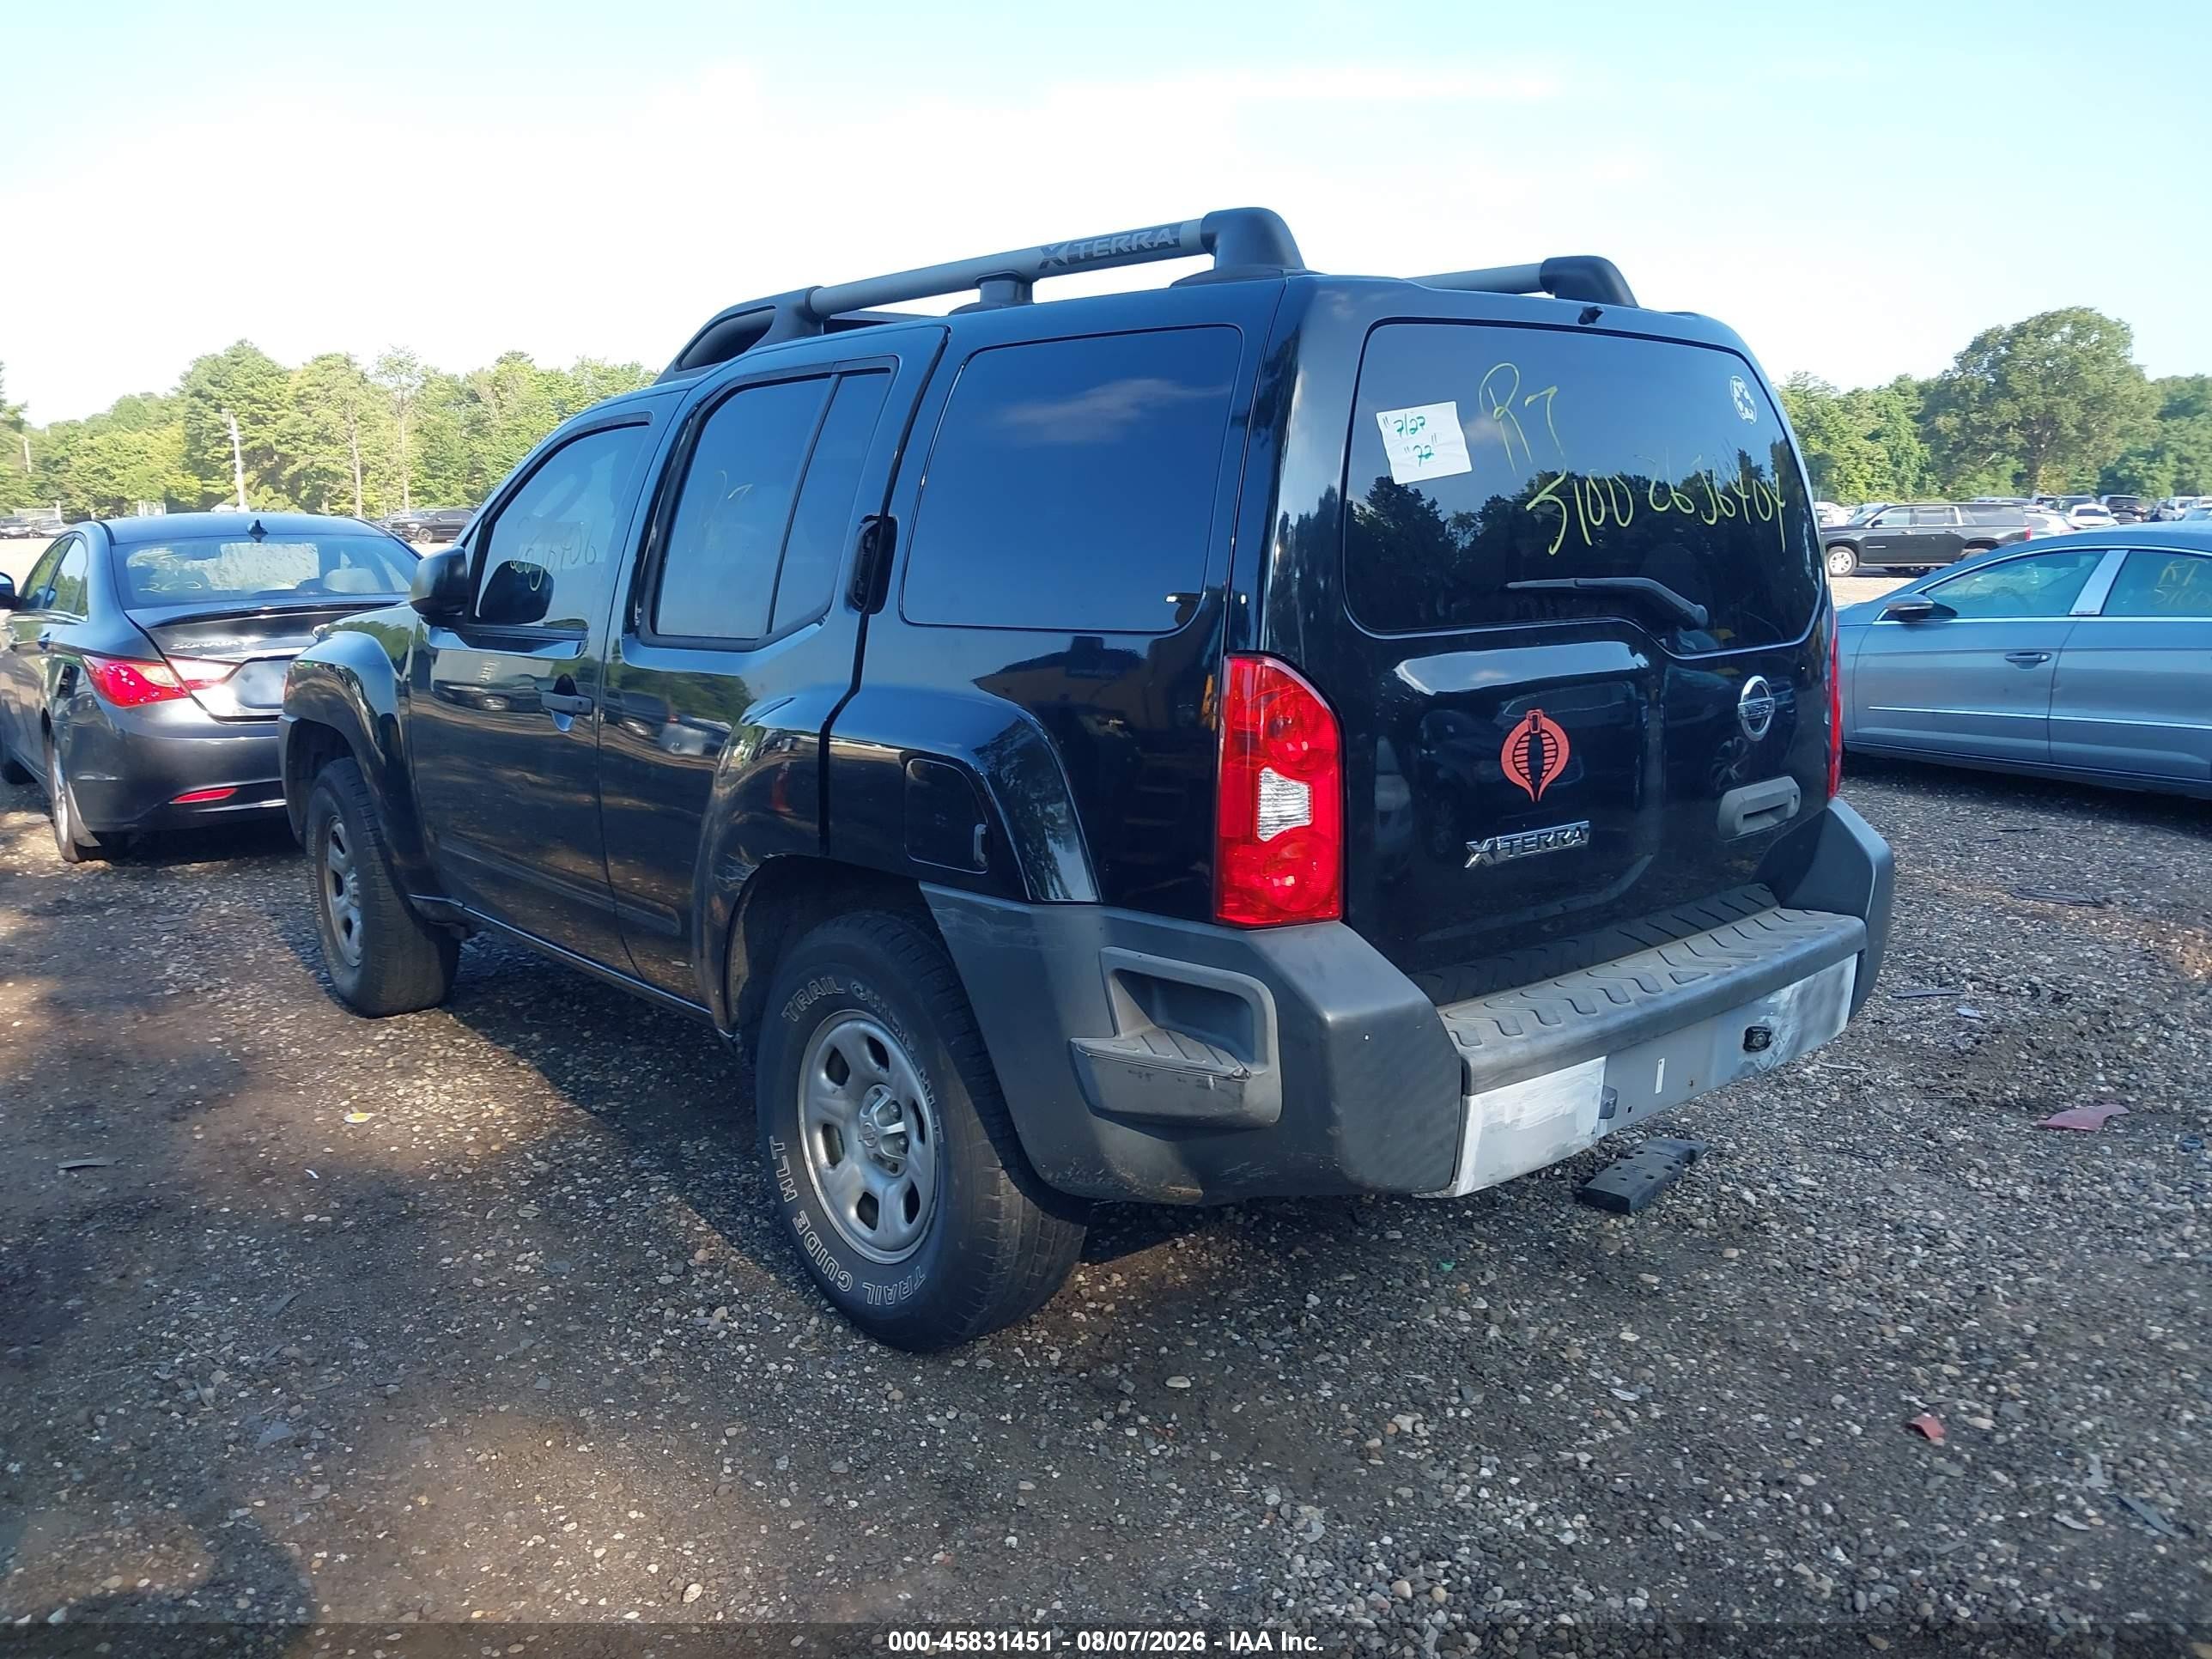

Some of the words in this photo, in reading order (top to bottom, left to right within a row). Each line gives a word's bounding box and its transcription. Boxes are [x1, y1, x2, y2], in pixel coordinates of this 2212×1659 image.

[1039, 227, 1176, 270] XTERRA
[1463, 820, 1589, 869] XTERRA
[781, 975, 845, 1022] TRAIL
[769, 1135, 798, 1202] HLT
[792, 1210, 854, 1292] GUIDE
[862, 1266, 927, 1305] TRAIL
